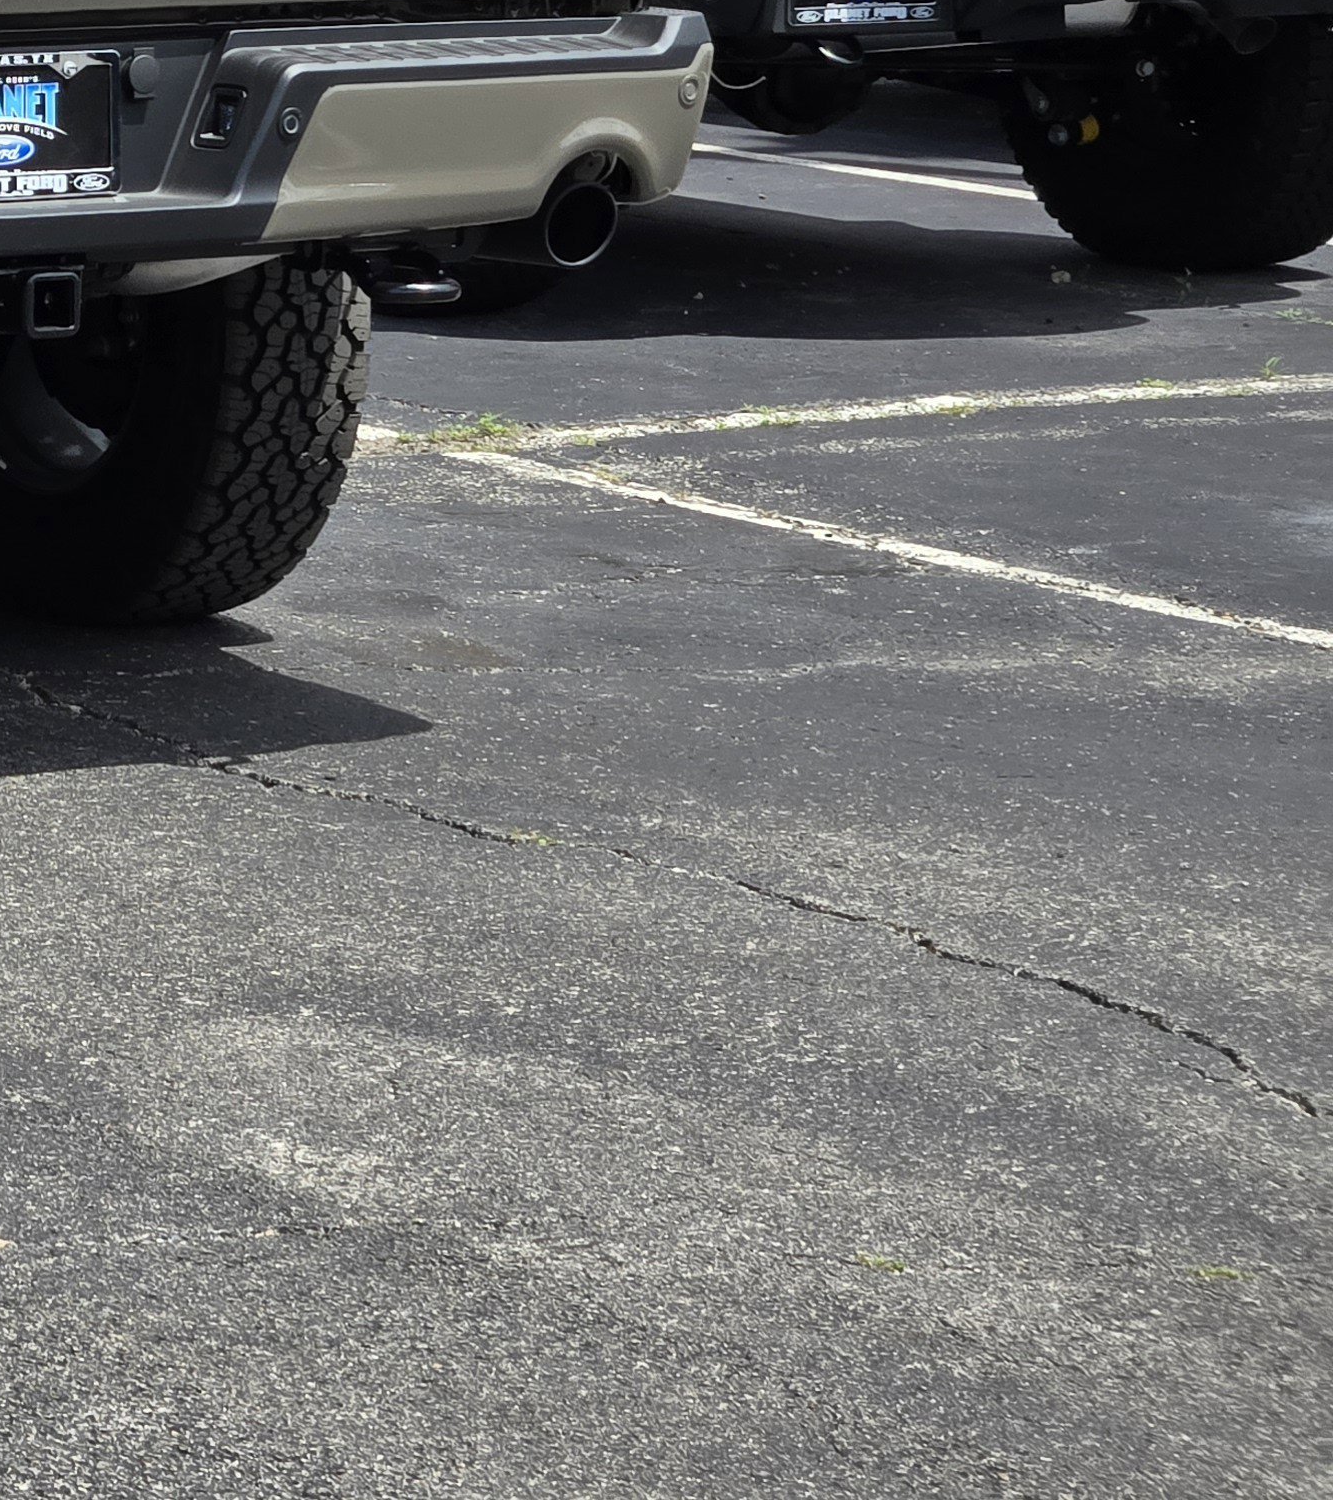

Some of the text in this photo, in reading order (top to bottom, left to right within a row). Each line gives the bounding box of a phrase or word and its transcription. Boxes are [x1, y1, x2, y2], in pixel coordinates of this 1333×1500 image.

[31, 51, 54, 63] TX
[23, 124, 55, 141] FIELD
[15, 174, 69, 194] FORD
